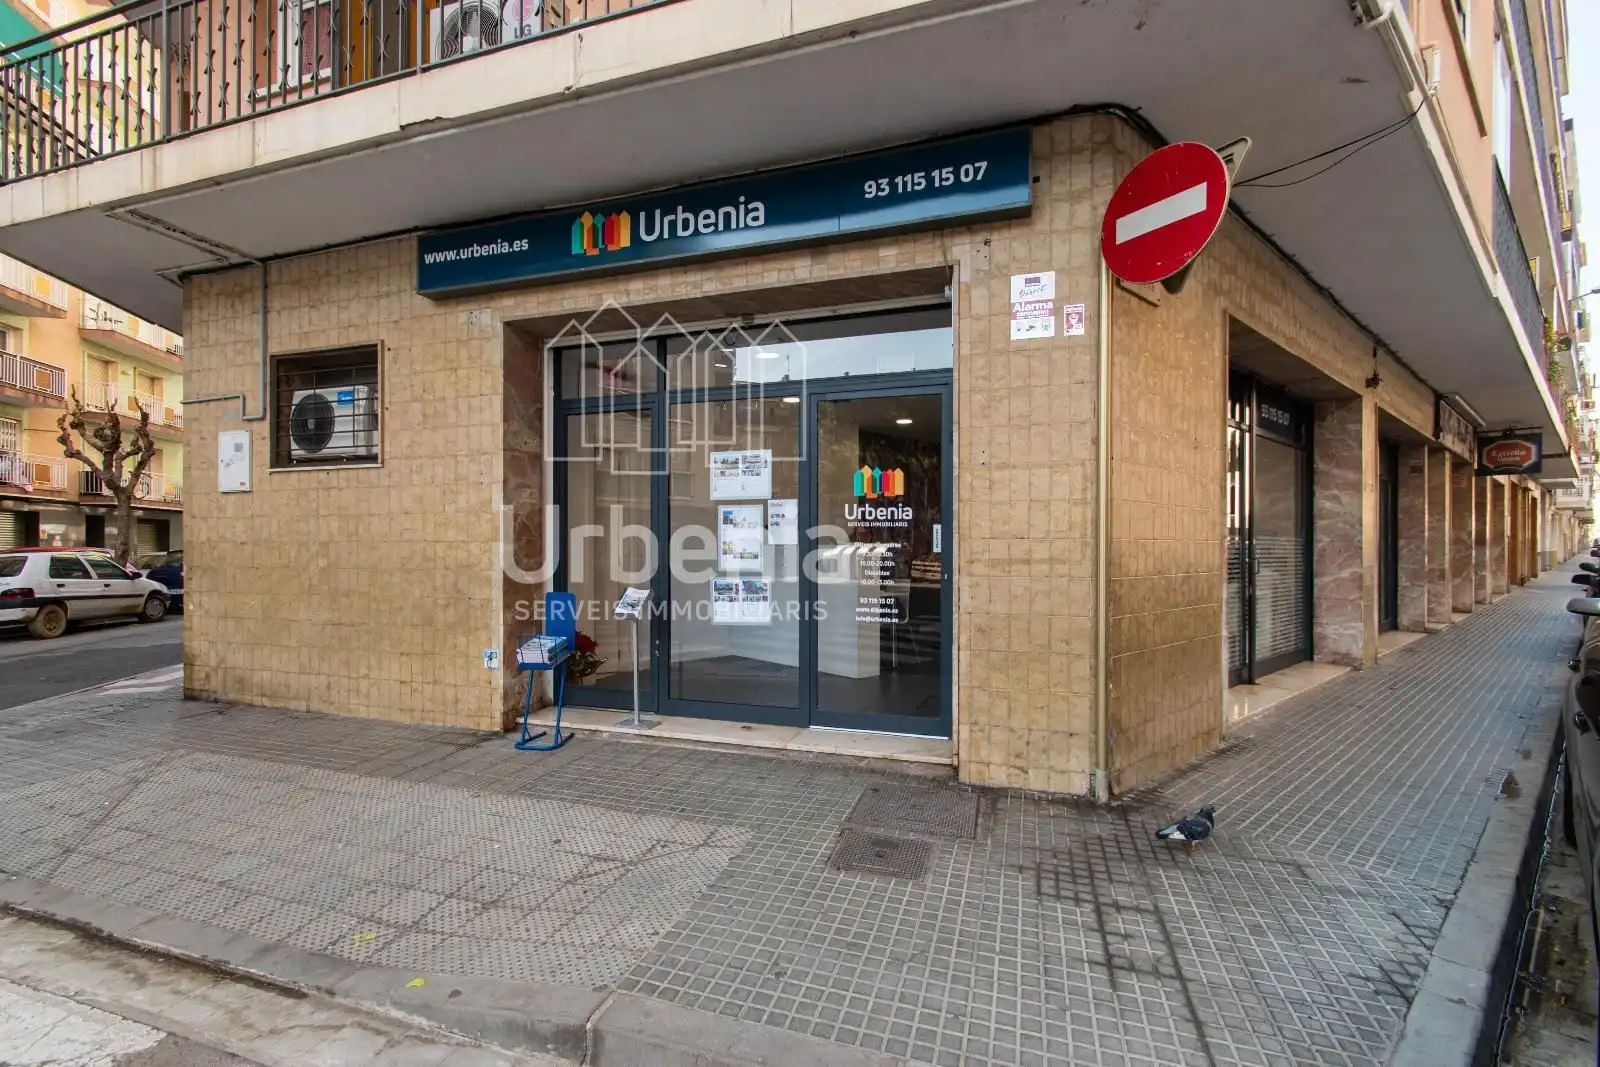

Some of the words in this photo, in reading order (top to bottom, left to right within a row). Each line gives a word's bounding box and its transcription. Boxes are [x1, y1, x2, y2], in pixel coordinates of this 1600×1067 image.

[864, 178, 890, 198] 93
[894, 171, 927, 193] 115
[931, 167, 954, 187] 15
[960, 161, 988, 183] 07
[639, 196, 765, 242] Urbenia
[424, 237, 529, 265] www.urbenia.es
[1013, 301, 1054, 313] Alarma
[844, 503, 913, 520] Urbenia
